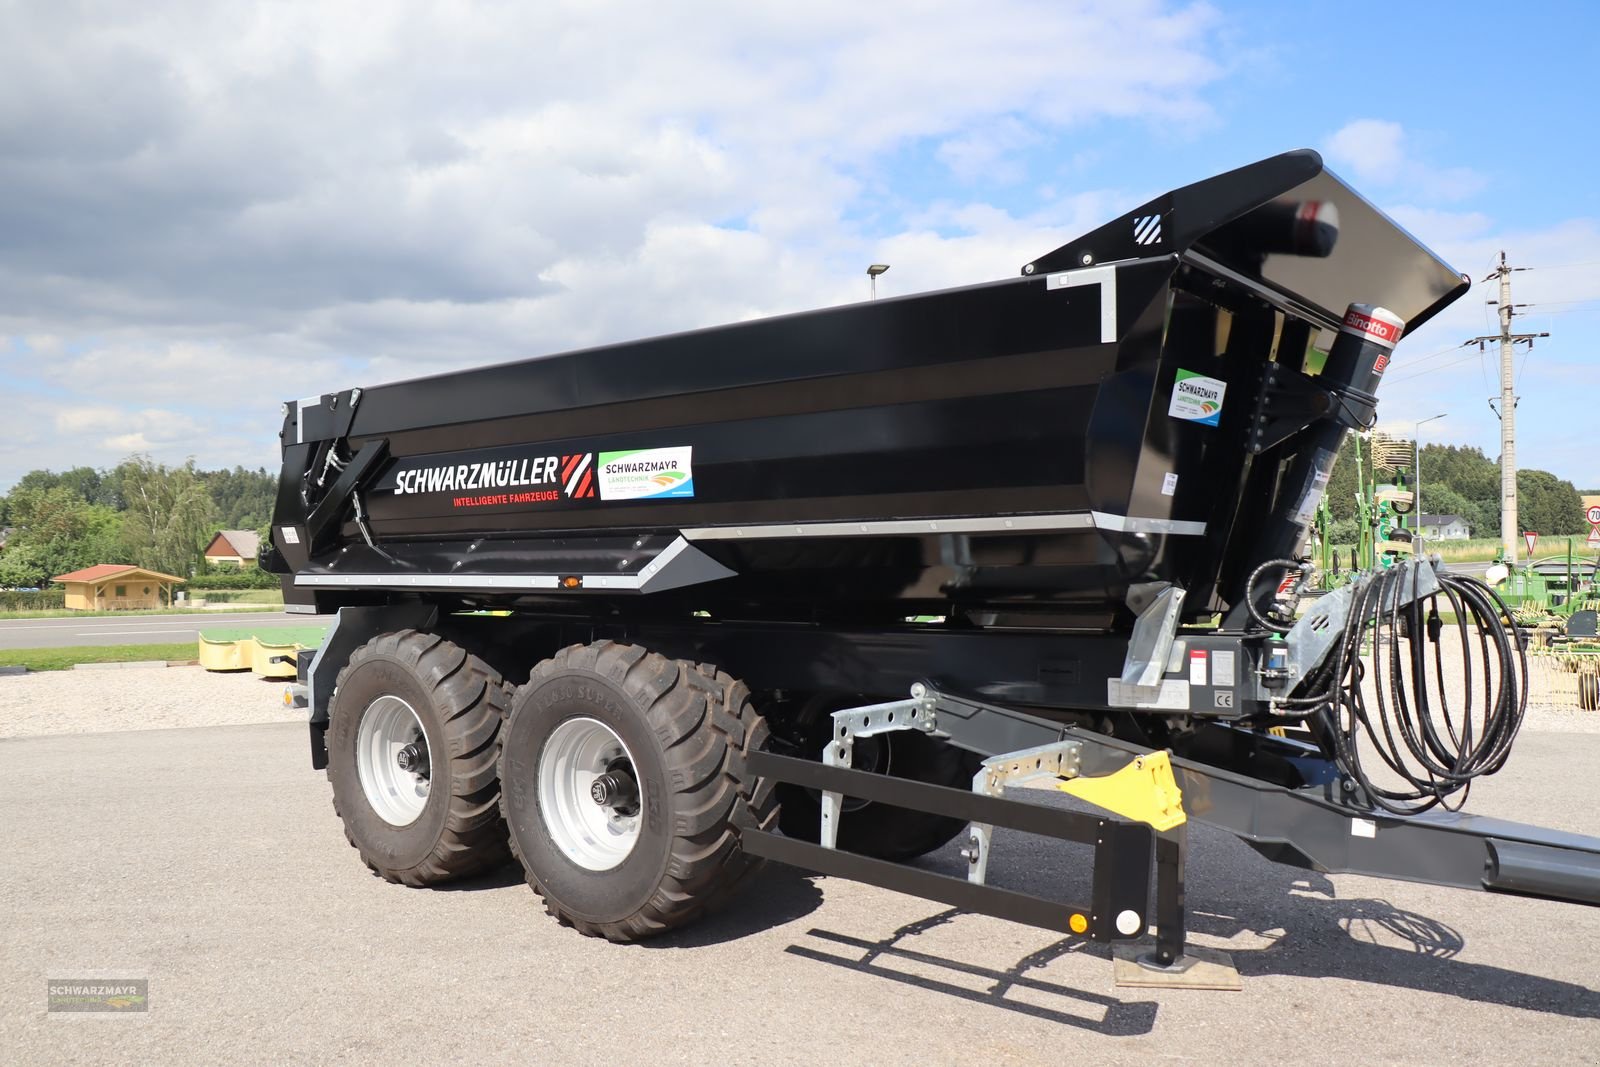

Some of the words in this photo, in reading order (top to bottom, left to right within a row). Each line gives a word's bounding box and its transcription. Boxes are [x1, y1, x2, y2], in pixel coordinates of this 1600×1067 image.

[1347, 312, 1388, 337] Binotto
[1178, 382, 1218, 400] SCHWARZMAYR
[606, 460, 678, 474] SCHWARZMAYR
[394, 456, 559, 495] SCHWARZMÜLLER
[608, 475, 649, 484] LANDTECHNIK
[453, 495, 508, 507] INTELLIGENTE
[509, 490, 559, 503] FAHRZEUGE
[1591, 510, 1600, 520] 70
[1216, 695, 1231, 706] CE
